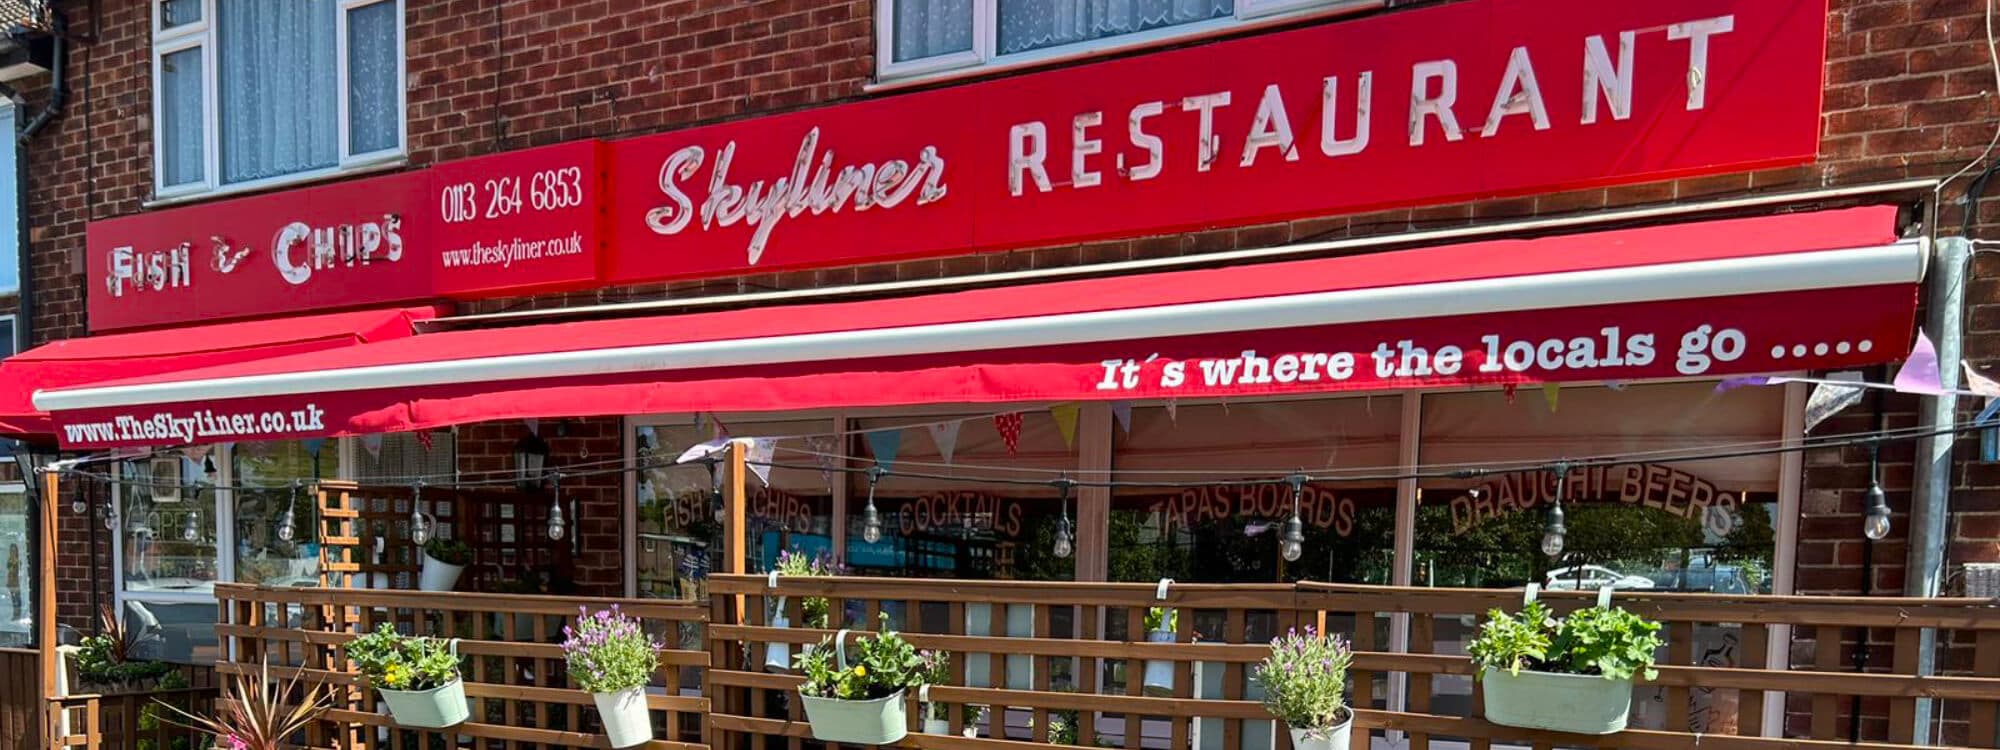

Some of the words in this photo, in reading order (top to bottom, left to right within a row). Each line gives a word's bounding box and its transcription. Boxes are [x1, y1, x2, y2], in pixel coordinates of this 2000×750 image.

[646, 126, 947, 265] Skyliner
[1010, 14, 1735, 197] RESTAURANT
[441, 182, 477, 223] 0113
[485, 176, 522, 218] 264
[530, 166, 582, 210] 6853
[442, 231, 582, 268] www.theskyliner.co.uk
[1200, 350, 1354, 386] where
[1371, 340, 1463, 378] the
[1479, 326, 1655, 373] locals
[1676, 324, 1746, 374] go
[64, 404, 324, 443] www.TheSkyliner.co.uk
[663, 489, 706, 534] FISH
[752, 488, 812, 532] CHIPS
[900, 491, 1021, 537] COCKTAILS
[1150, 483, 1231, 538] TAPAS
[1239, 481, 1355, 537] BOARDS
[1451, 464, 1612, 536] DRAUGHT
[1620, 463, 1736, 537] BEERS
